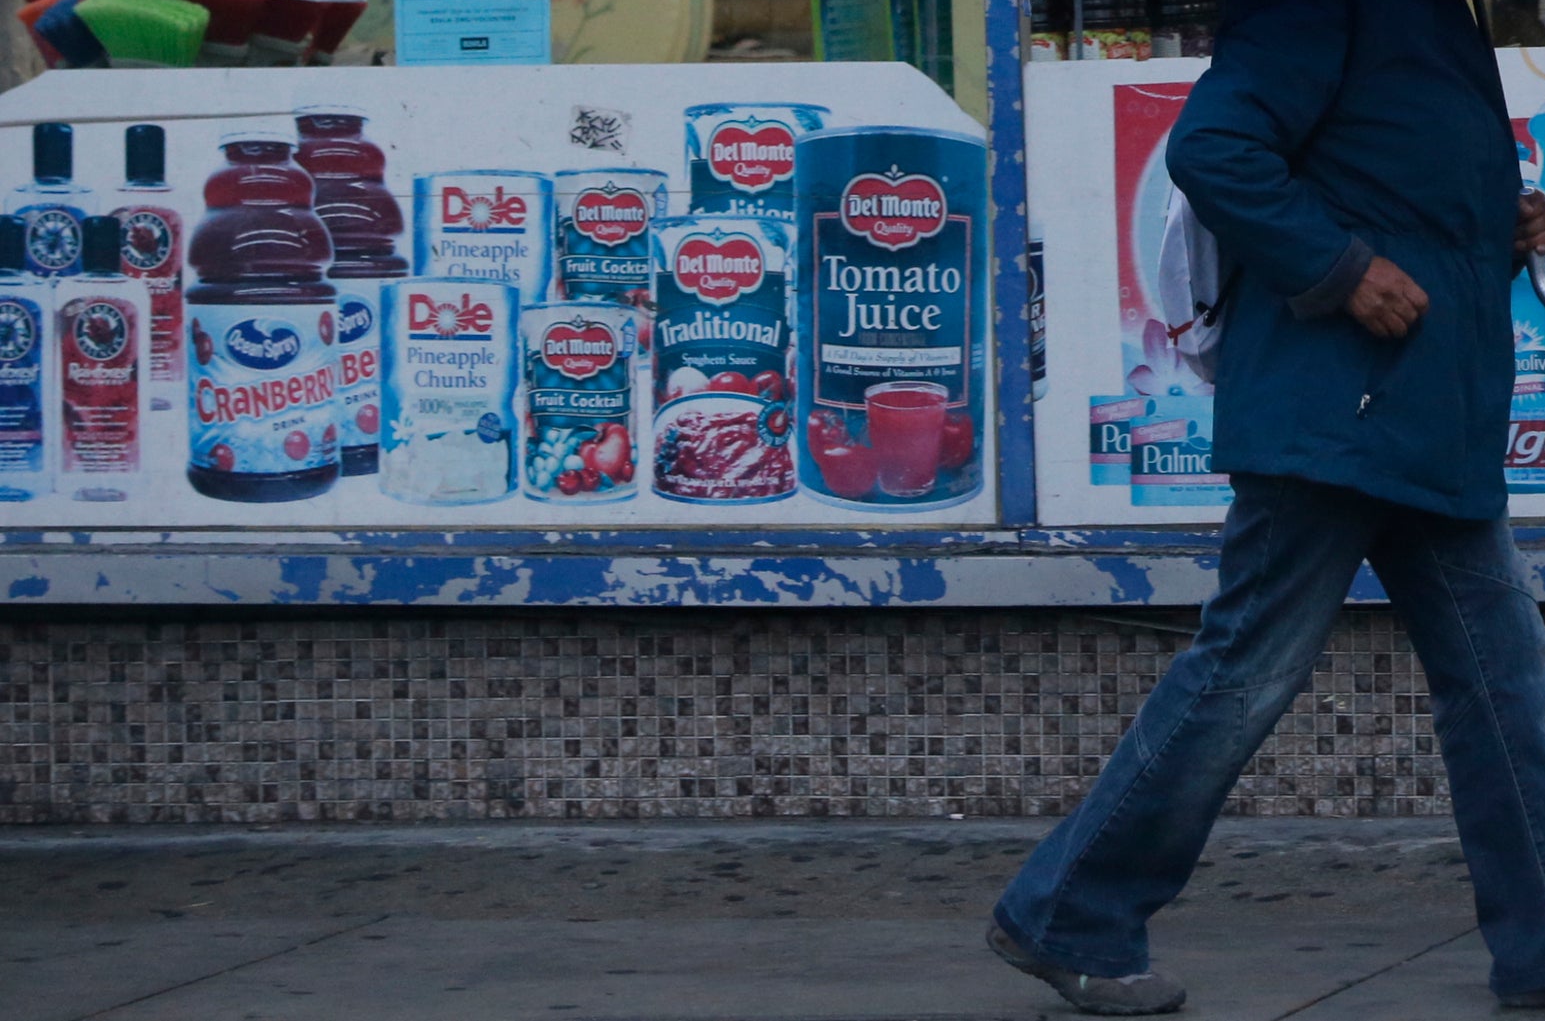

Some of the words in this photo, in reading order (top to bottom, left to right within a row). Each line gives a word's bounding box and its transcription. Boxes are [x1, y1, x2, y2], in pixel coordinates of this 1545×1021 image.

[713, 142, 738, 162] Del
[741, 142, 793, 162] Monte
[733, 163, 772, 178] Quality
[442, 186, 527, 229] Dole
[576, 206, 600, 221] Del
[601, 205, 644, 221] Monte
[848, 194, 878, 217] Del
[881, 195, 941, 218] Monte
[873, 221, 914, 237] Quality
[440, 239, 529, 264] Pineapple
[566, 259, 597, 273] Fruit
[679, 255, 704, 274] Del
[706, 255, 760, 274] Monte
[700, 275, 737, 290] Quality
[822, 255, 961, 294] Tomato
[408, 293, 493, 336] Dole
[838, 293, 942, 338] Juice
[658, 311, 782, 348] Traditional
[228, 329, 264, 358] Ocean
[263, 334, 299, 362] Spray
[546, 338, 569, 355] Del
[569, 338, 613, 356] Monte
[407, 346, 495, 370] Pineapple
[681, 353, 727, 367] Spaghetti
[728, 353, 758, 365] Sauce
[414, 370, 487, 388] Chunks
[535, 393, 565, 407] Fruit
[569, 393, 624, 408] Cocktail
